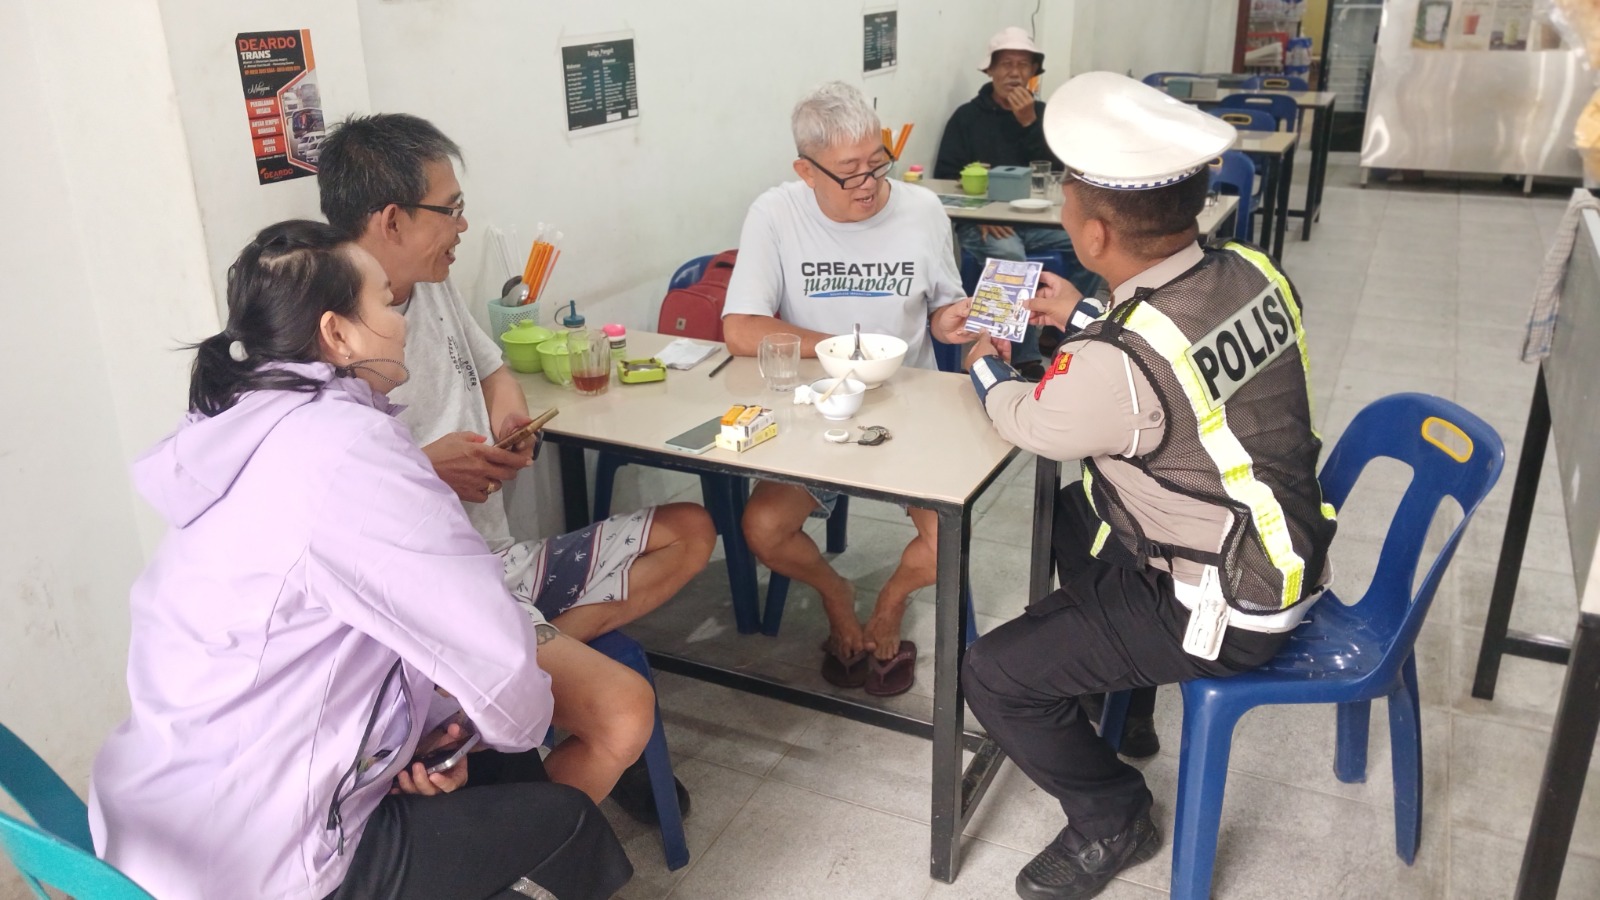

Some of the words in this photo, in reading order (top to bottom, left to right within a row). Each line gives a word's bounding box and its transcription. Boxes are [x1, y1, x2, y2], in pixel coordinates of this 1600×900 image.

[238, 36, 297, 51] DEARDO
[240, 50, 271, 60] TRANS
[263, 168, 294, 180] DEARDO
[801, 262, 914, 277] CREATIVE
[803, 272, 914, 296] Department
[1192, 287, 1297, 401] POLISI
[463, 360, 477, 387] POWER
